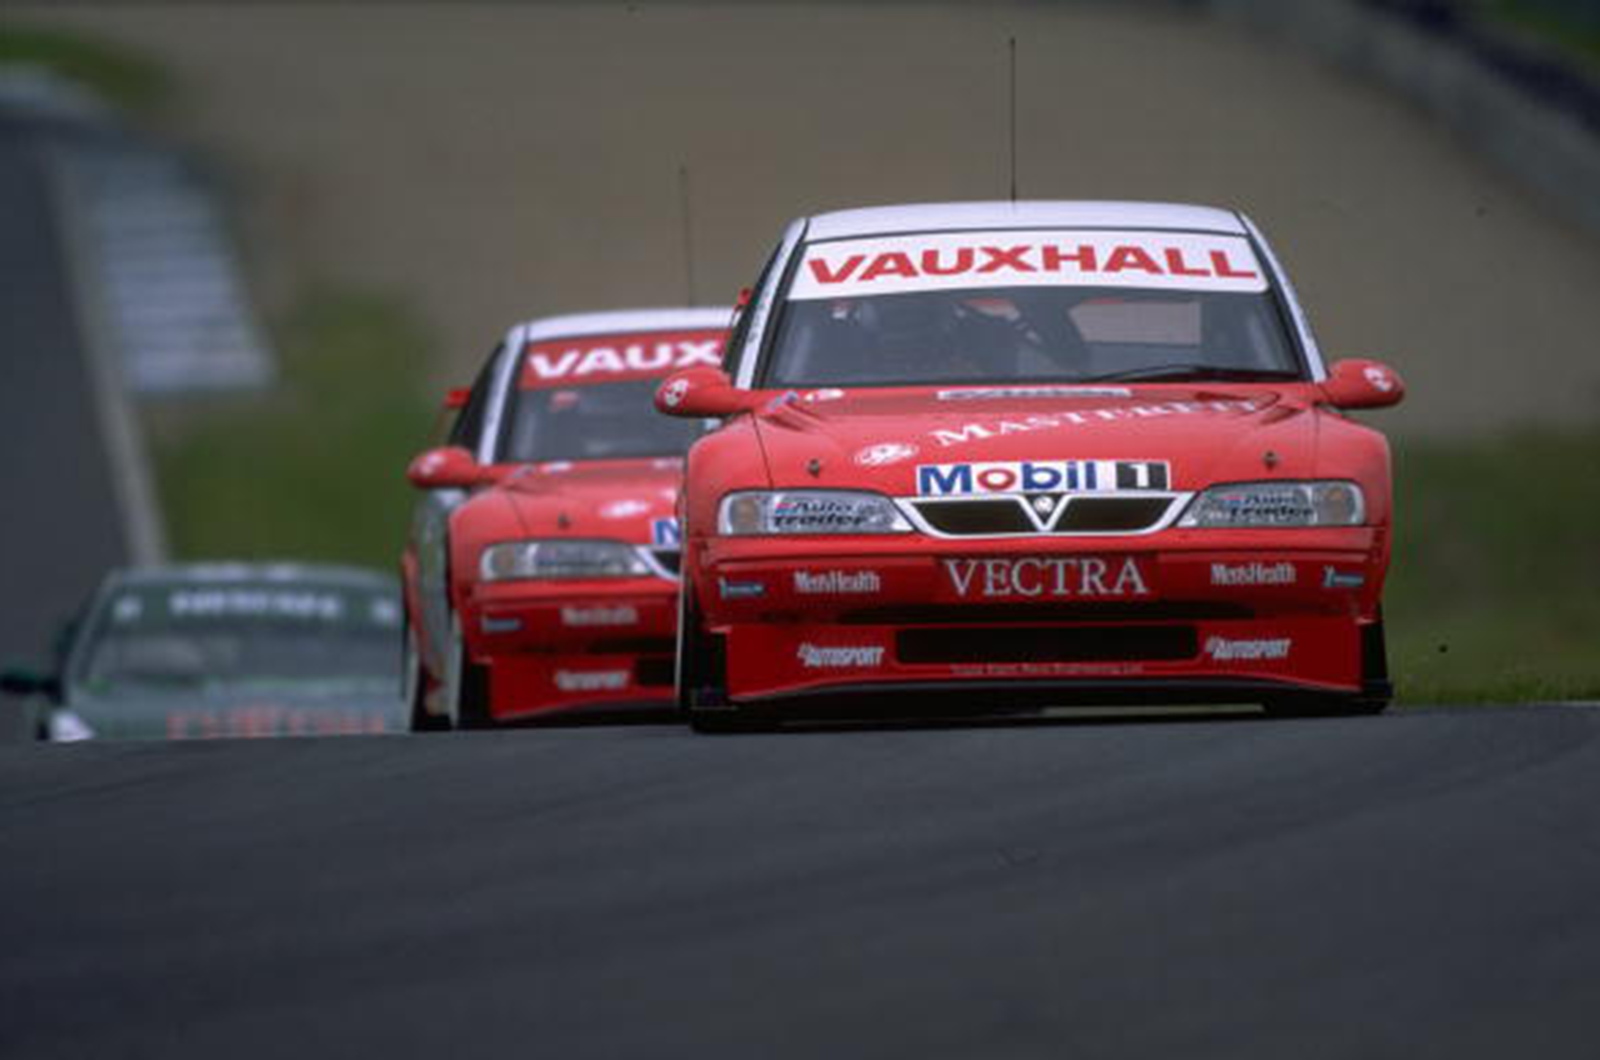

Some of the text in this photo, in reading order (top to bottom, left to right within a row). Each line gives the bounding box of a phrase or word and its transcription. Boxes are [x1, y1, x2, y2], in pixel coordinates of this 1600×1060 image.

[807, 244, 1258, 284] VAUXHALL
[918, 462, 1151, 495] Mobil 1
[942, 556, 1149, 597] VECTRA
